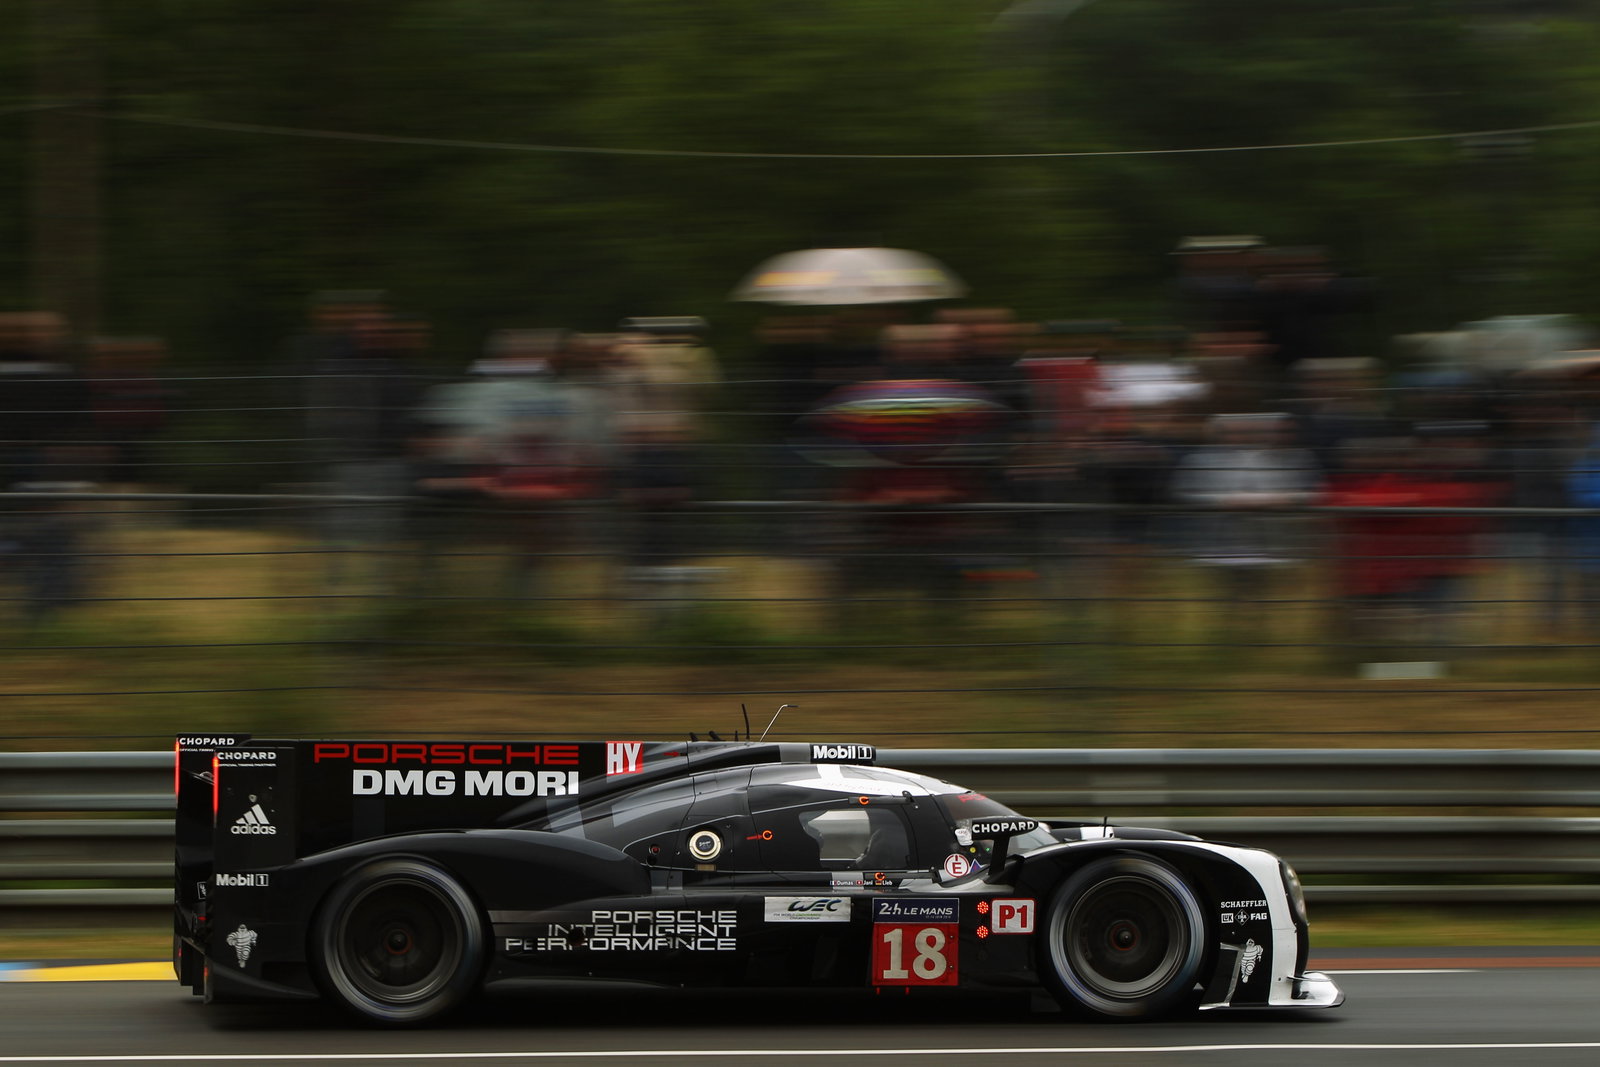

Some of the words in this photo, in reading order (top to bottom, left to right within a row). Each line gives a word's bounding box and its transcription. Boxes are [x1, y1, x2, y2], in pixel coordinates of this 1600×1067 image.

[179, 737, 235, 746] CHOPARD
[217, 752, 277, 760] CHOPARD
[313, 743, 579, 764] PORSCHE
[606, 742, 643, 775] HY
[813, 745, 856, 760] Mobil
[352, 769, 456, 796] DMG
[464, 770, 579, 797] MORI
[231, 823, 276, 835] adidas
[972, 821, 1035, 834] CHOPARD
[951, 862, 963, 874] E
[216, 873, 254, 887] Mobil
[787, 899, 842, 912] WEC
[903, 907, 917, 915] LE
[919, 907, 953, 915] MANS
[1220, 900, 1267, 908] SCHAEFFLER
[591, 910, 737, 924] PORSCHE
[999, 904, 1028, 929] P1
[548, 923, 737, 937] INTELLIGENT
[882, 927, 947, 980] 18
